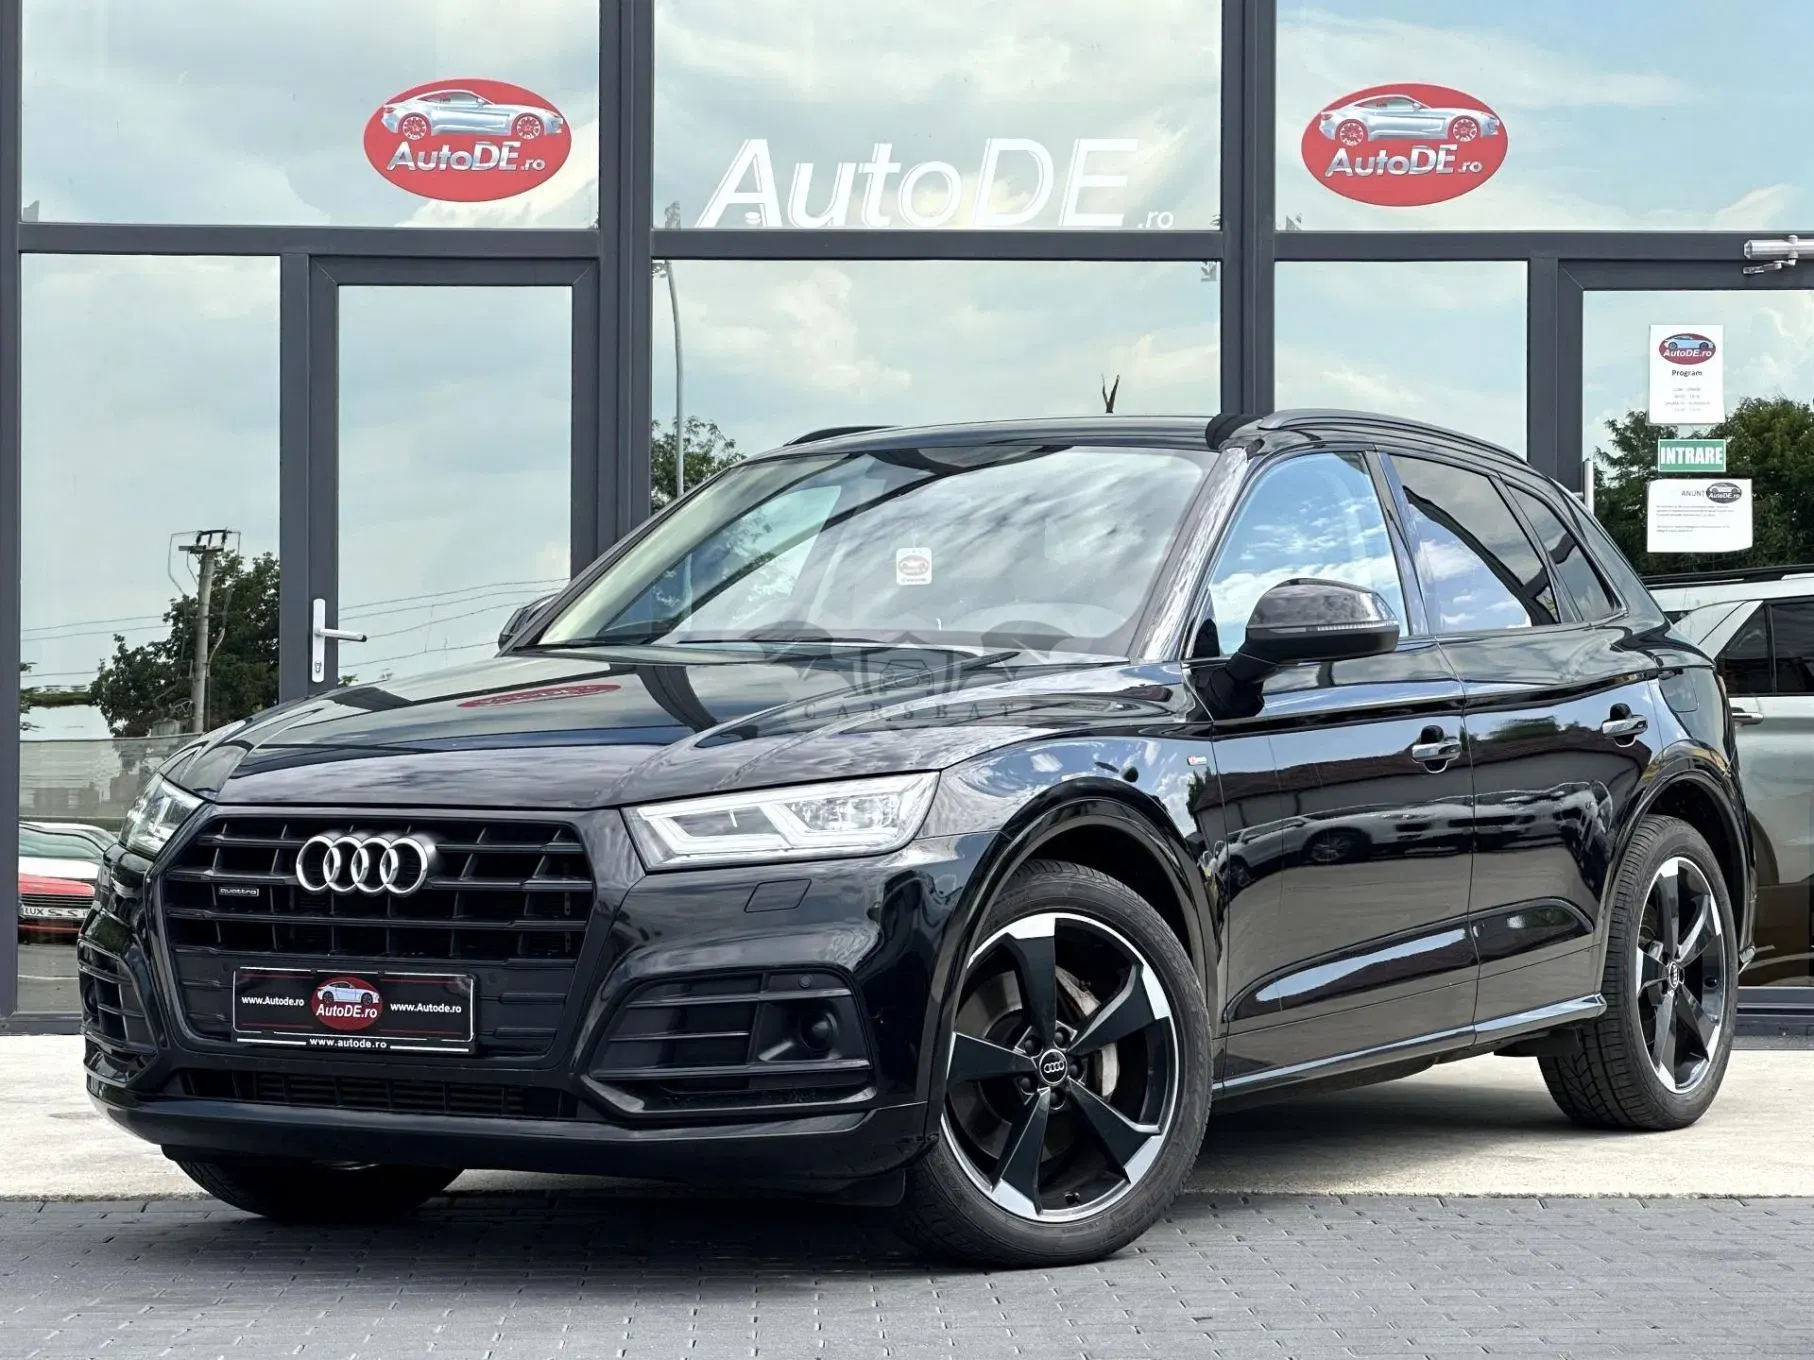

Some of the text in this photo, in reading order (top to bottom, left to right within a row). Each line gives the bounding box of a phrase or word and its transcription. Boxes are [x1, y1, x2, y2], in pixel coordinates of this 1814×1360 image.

[1663, 349, 1712, 357] AutoDE.ro
[1671, 369, 1703, 377] Program
[1660, 447, 1723, 465] INTRARE
[241, 996, 305, 1007] www.Autode.ro
[315, 1003, 378, 1019] AutoDE.ro
[389, 1002, 462, 1014] www.Autode.ro
[309, 1037, 388, 1049] www.autode.ro
